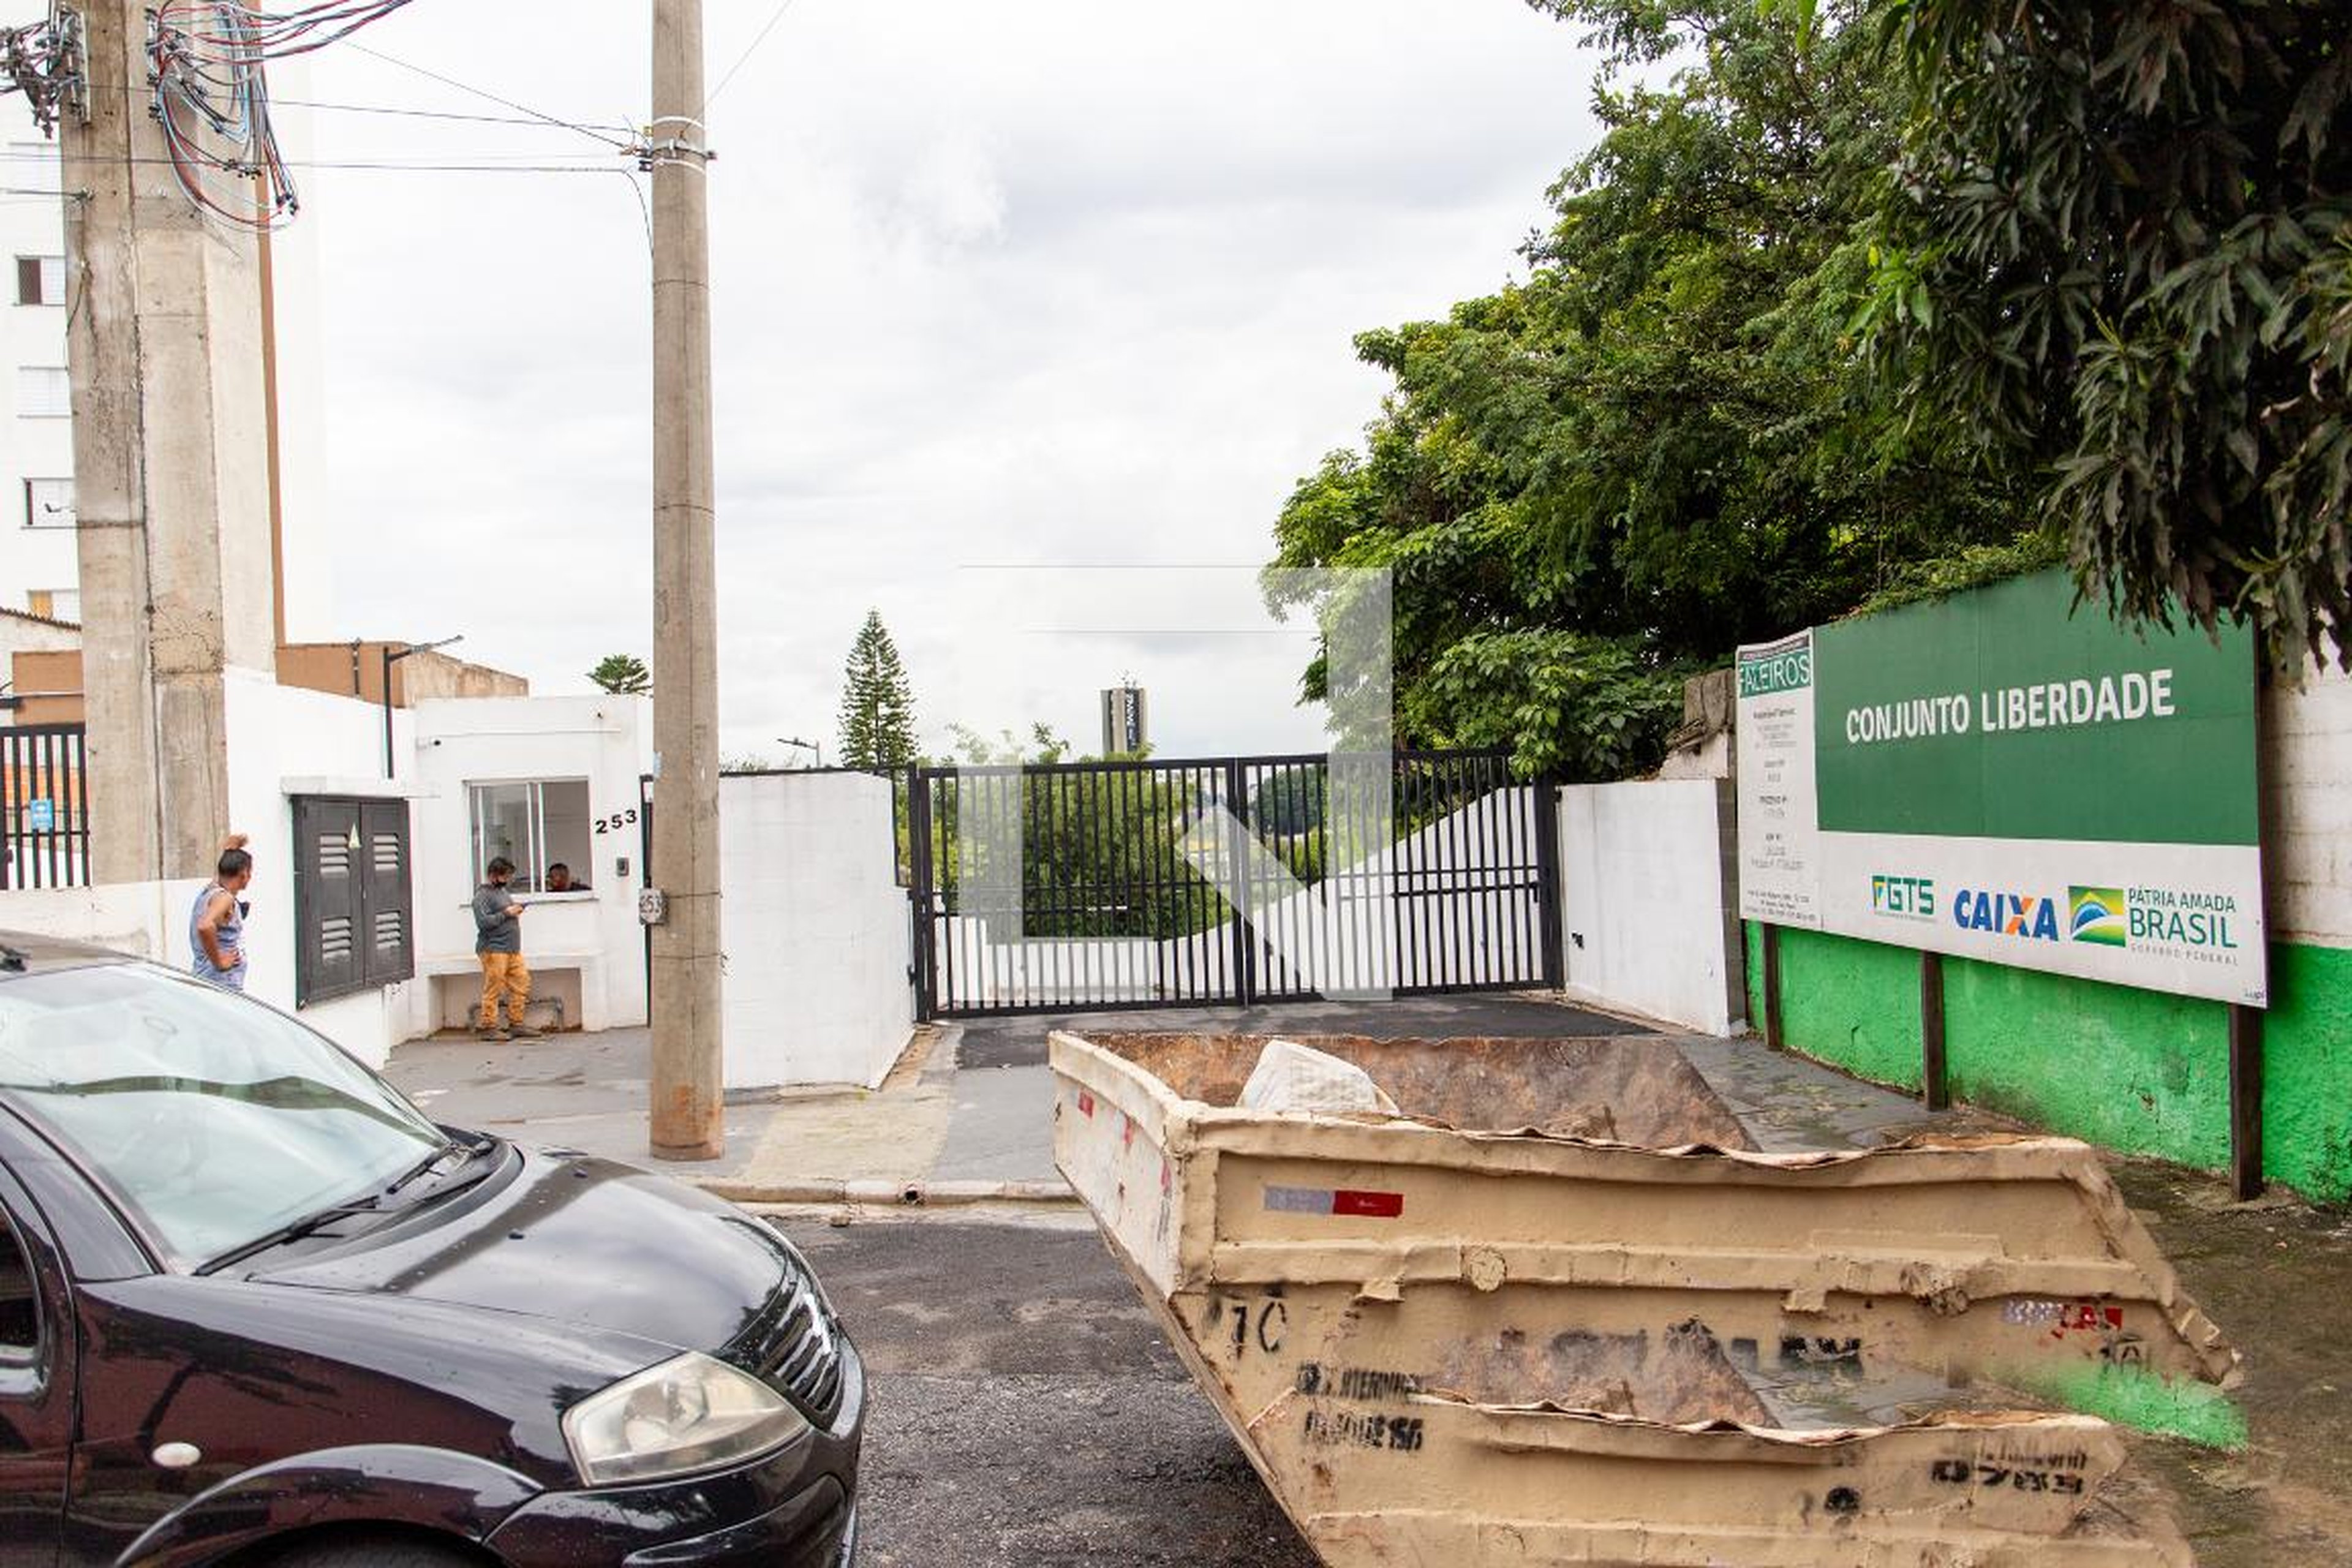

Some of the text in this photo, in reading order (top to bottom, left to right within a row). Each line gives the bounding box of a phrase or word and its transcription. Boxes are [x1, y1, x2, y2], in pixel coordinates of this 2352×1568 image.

[1845, 694, 1970, 743] CONJUNTO
[1981, 669, 2176, 732] LIBERDADE
[595, 809, 636, 834] 253
[1872, 875, 1934, 915] FGTS
[1953, 889, 2059, 941] CAIXA
[2180, 892, 2236, 913] AMADA
[2130, 907, 2238, 948] BRASIL
